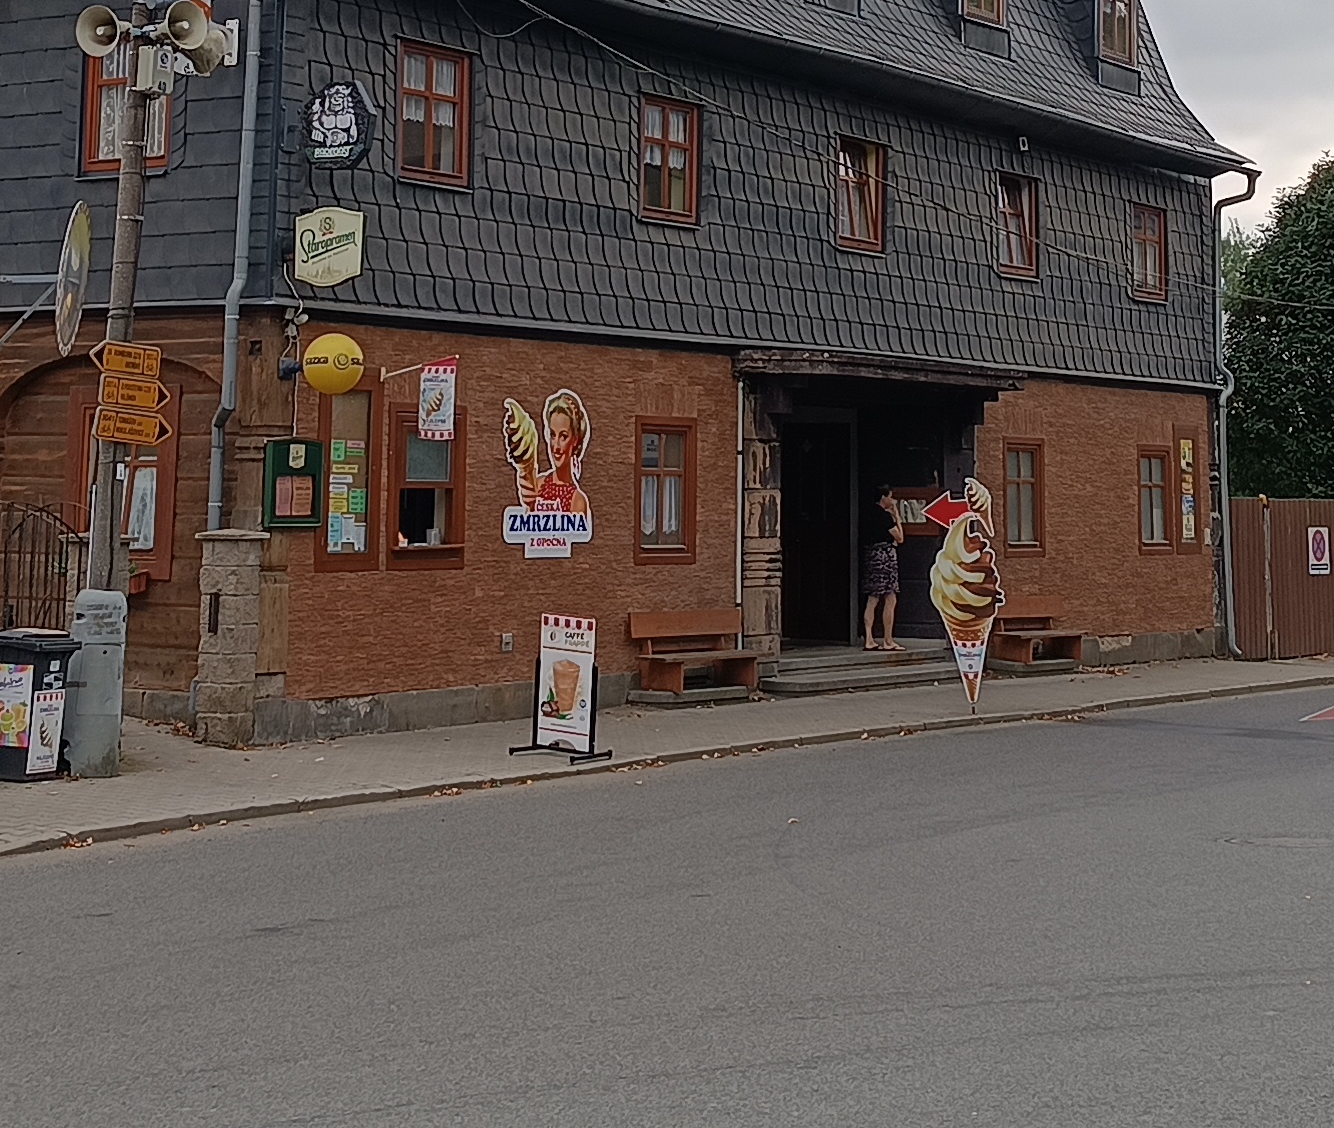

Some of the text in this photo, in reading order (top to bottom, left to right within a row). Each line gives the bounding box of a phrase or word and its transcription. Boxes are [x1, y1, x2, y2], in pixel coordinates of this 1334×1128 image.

[299, 228, 358, 264] Staropramen
[508, 513, 588, 532] ZMRZLINA
[530, 538, 535, 547] Z
